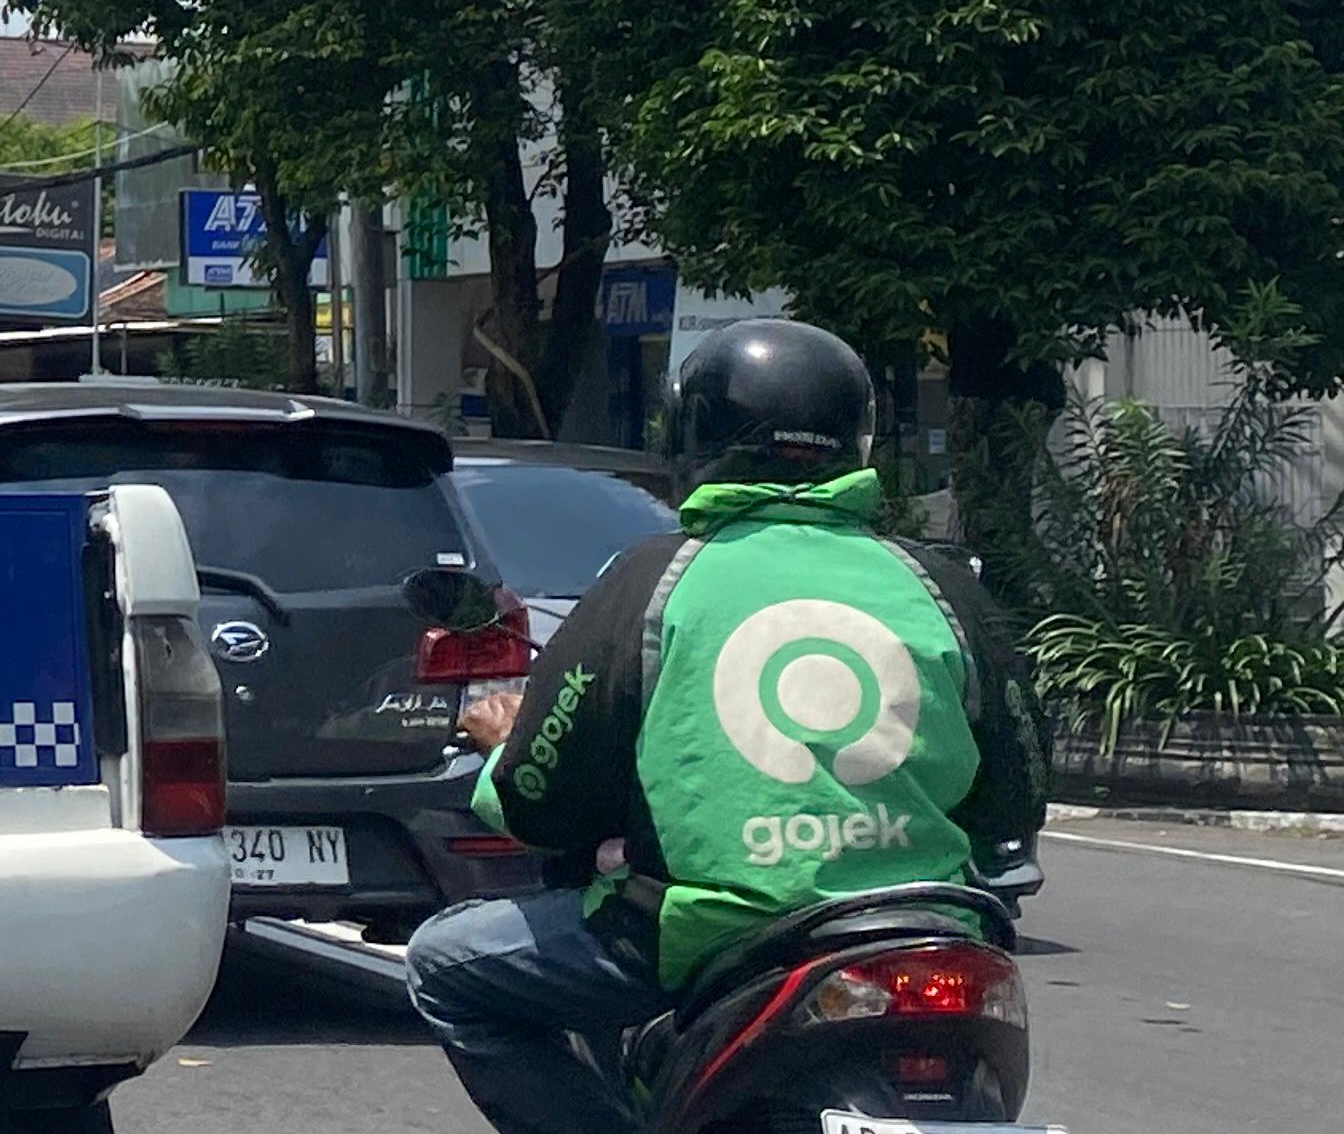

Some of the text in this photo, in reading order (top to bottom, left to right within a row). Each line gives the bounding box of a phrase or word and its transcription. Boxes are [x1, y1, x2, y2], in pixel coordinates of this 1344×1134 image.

[530, 664, 595, 770] gojek
[306, 829, 339, 864] NY
[741, 803, 913, 865] gojek
